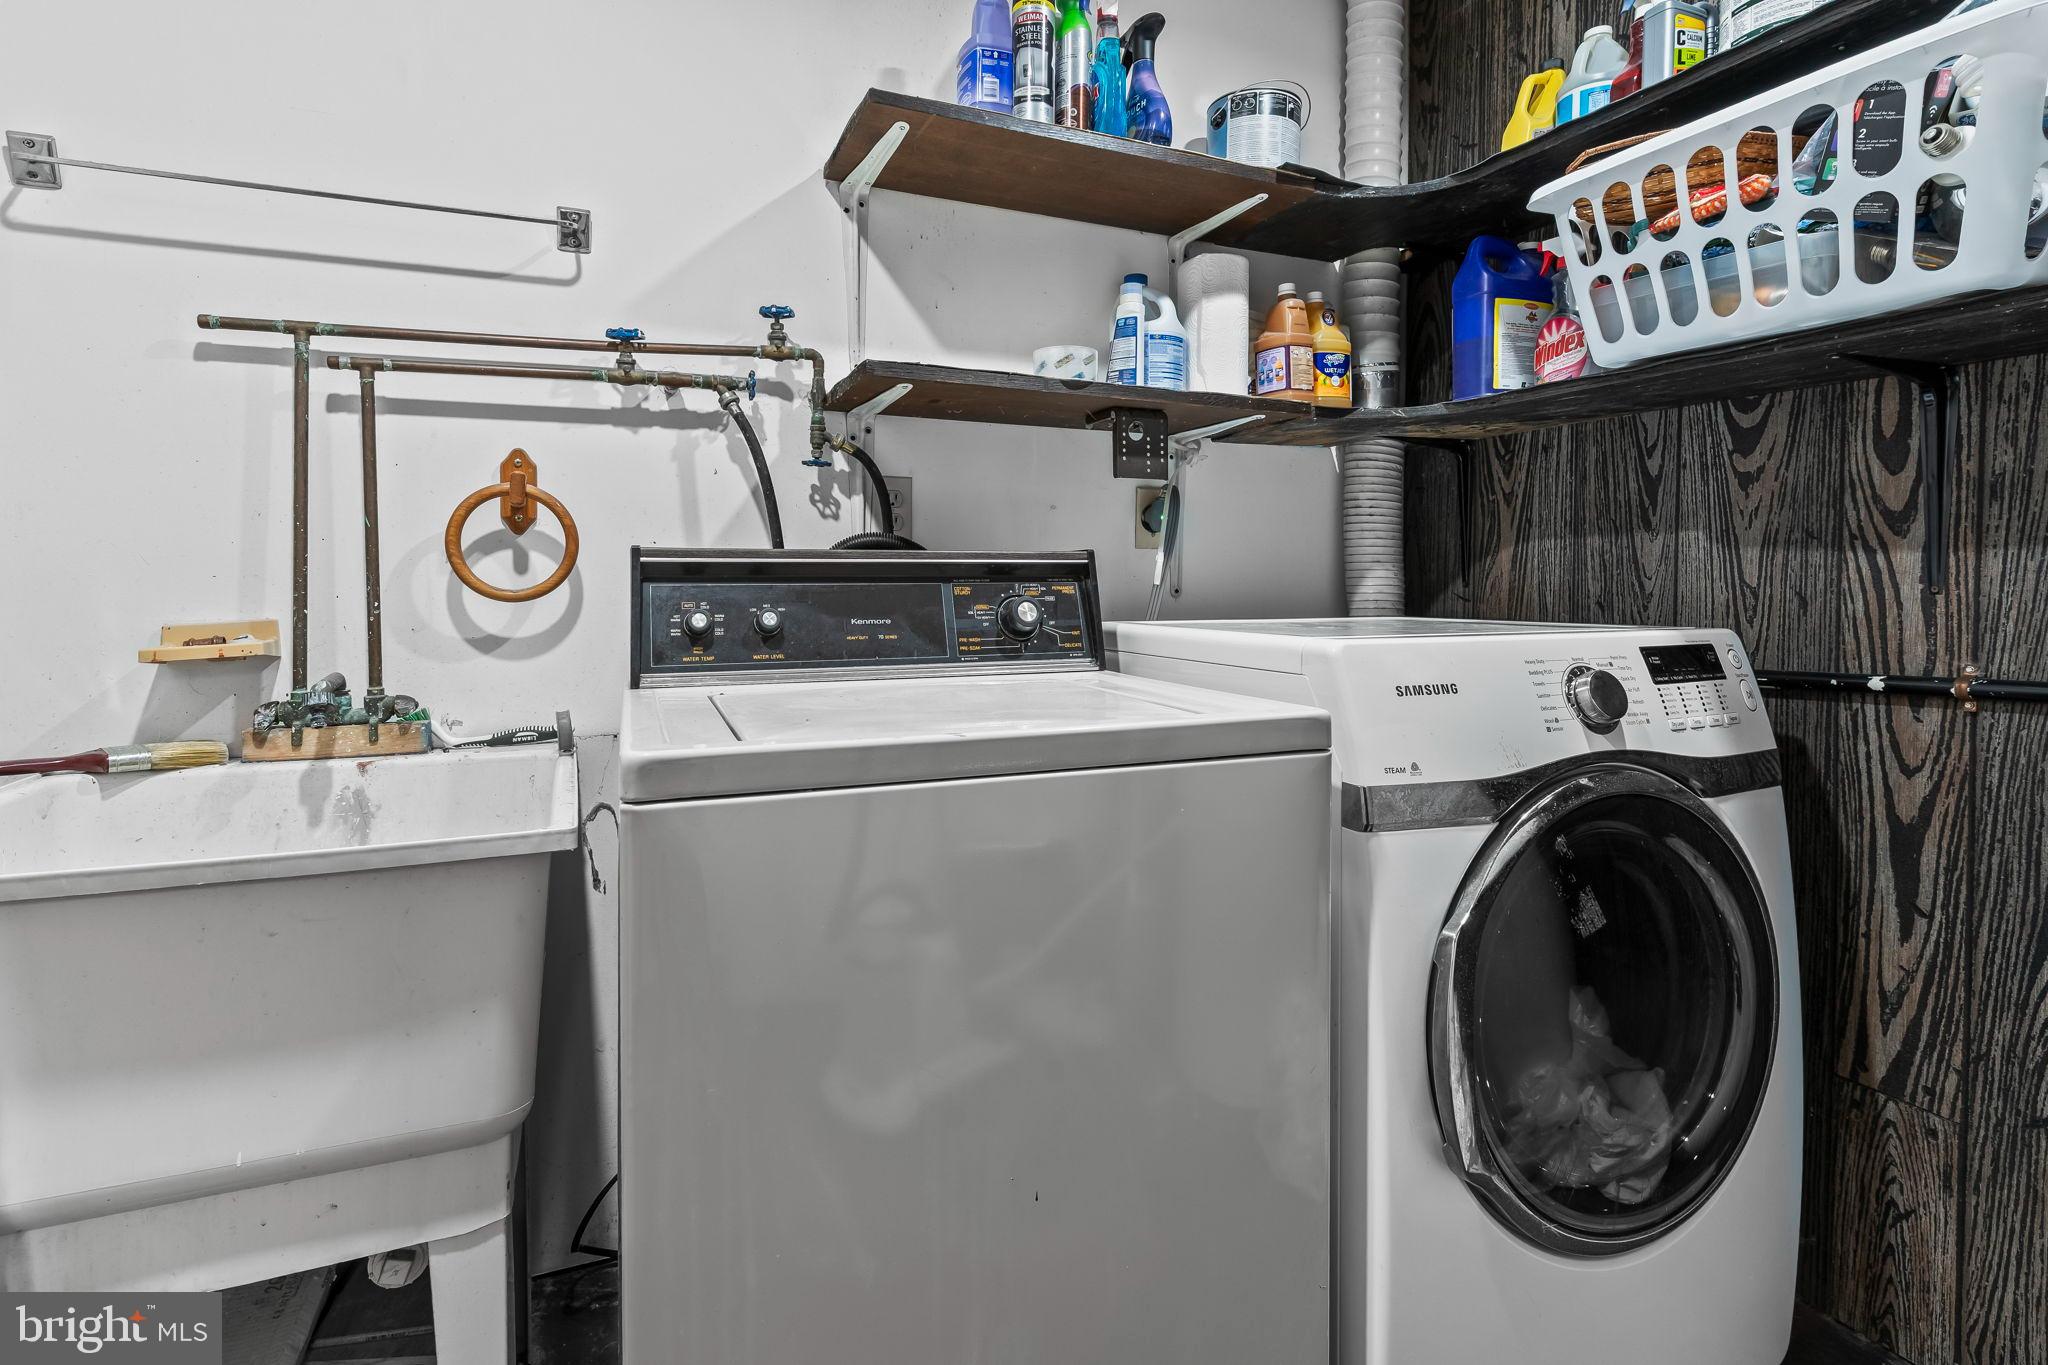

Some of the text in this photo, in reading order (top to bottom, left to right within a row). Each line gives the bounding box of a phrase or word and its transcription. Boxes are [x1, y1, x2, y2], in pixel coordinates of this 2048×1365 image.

[1021, 32, 1043, 41] STEEL
[1869, 99, 1875, 109] 1
[1858, 128, 1867, 139] 2
[1534, 330, 1585, 371] Windex
[752, 653, 770, 661] WATER
[1395, 683, 1458, 697] SAMSUNG
[1384, 767, 1407, 775] STEAM
